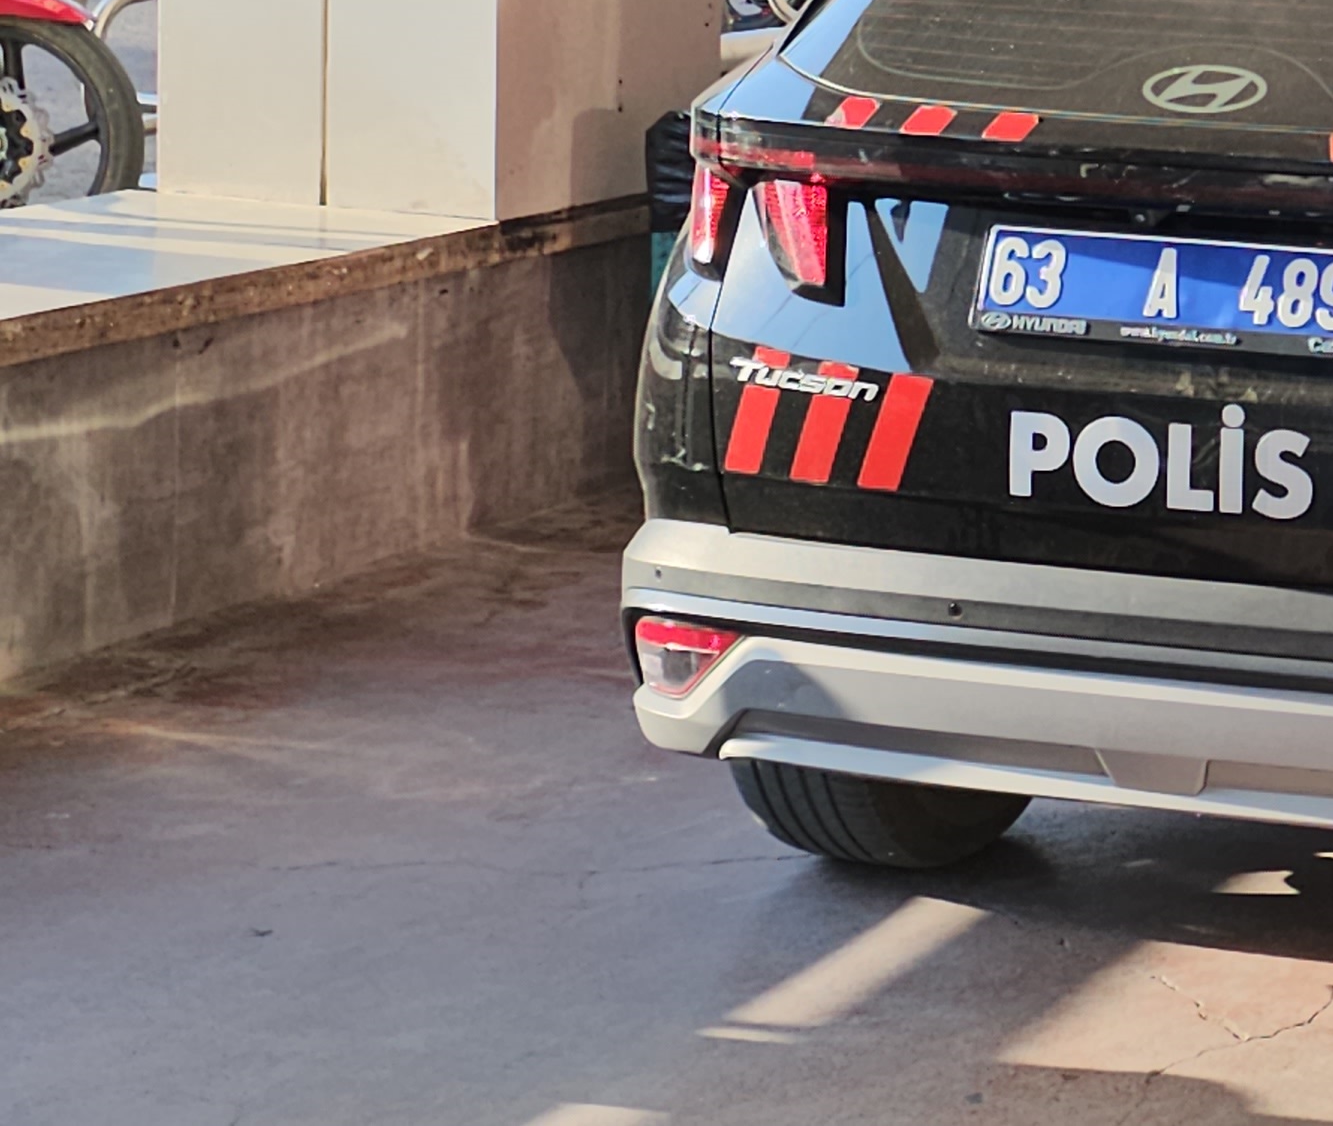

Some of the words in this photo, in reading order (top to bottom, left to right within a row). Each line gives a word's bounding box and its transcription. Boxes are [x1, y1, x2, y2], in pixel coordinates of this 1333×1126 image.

[988, 236, 1067, 309] 63
[1142, 246, 1178, 319] A
[1012, 314, 1088, 336] HYUNDAI
[1009, 403, 1314, 520] POLİS
